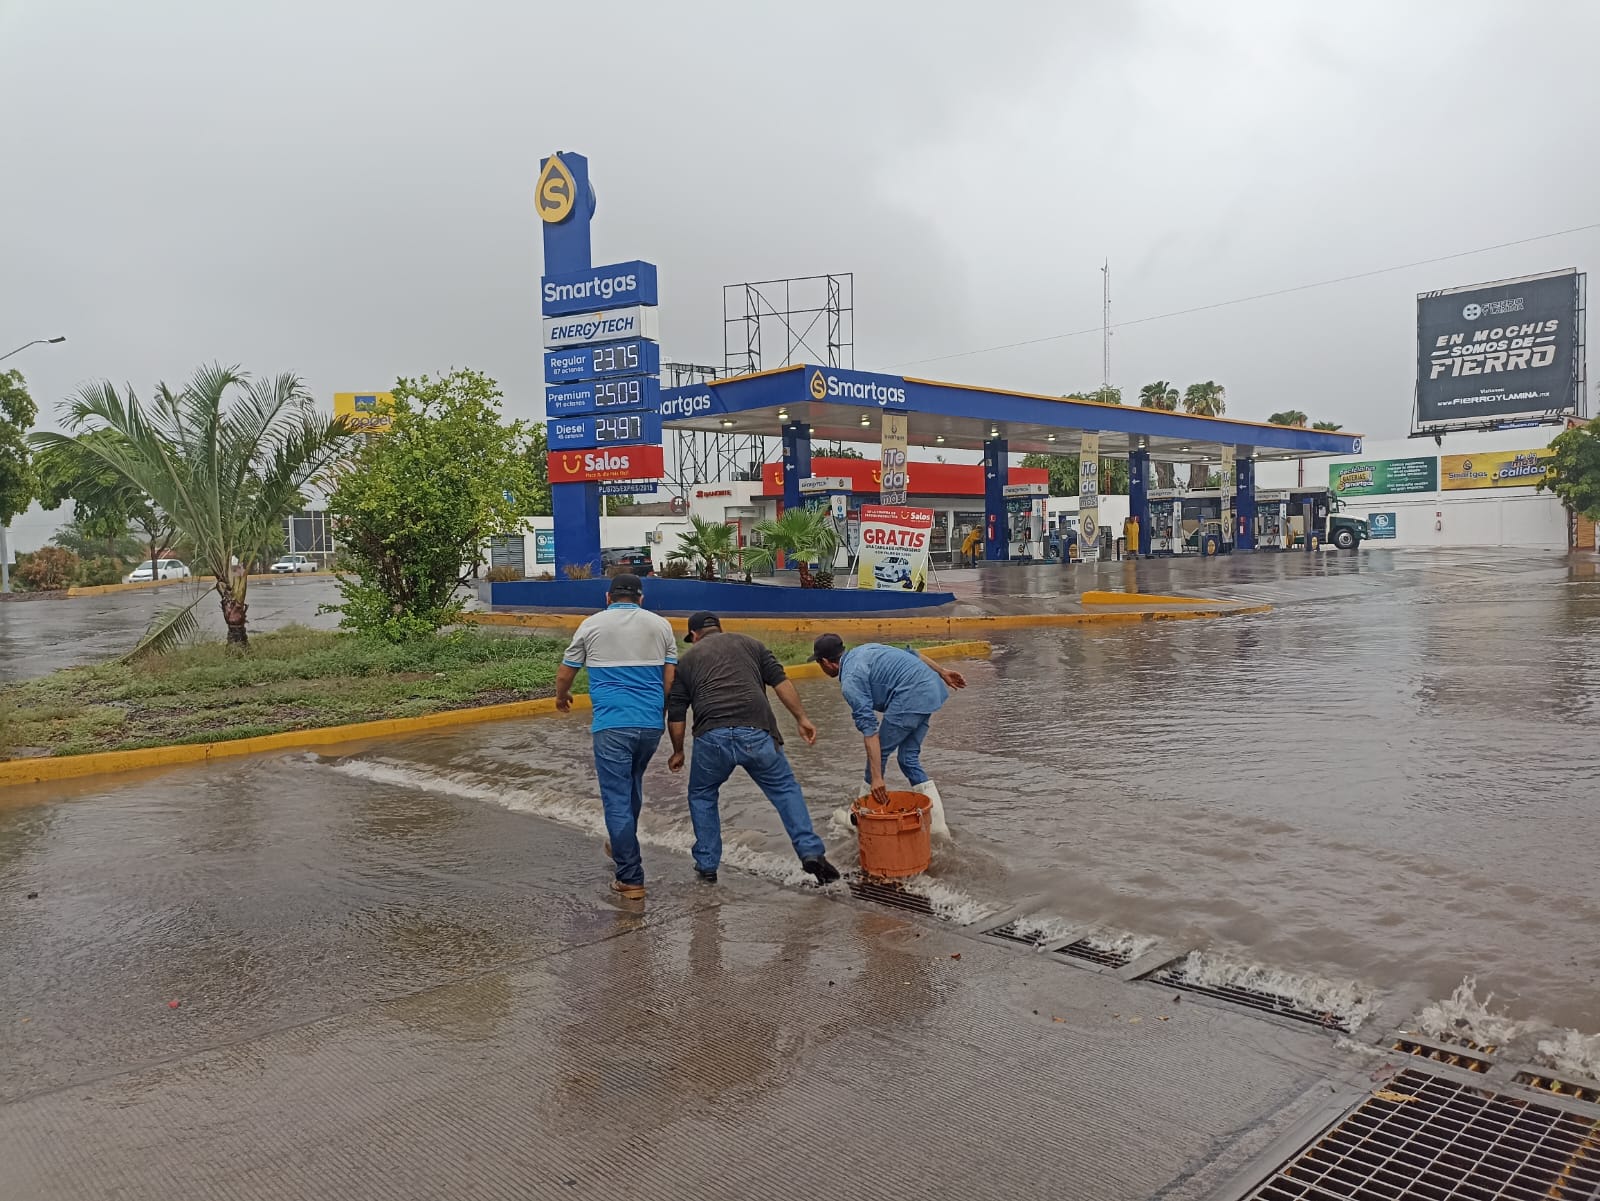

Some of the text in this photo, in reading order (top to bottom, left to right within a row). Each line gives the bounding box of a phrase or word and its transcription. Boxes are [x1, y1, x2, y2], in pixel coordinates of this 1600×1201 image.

[544, 274, 637, 302] Smartgas
[551, 315, 634, 340] ENERGYTECH
[1436, 319, 1559, 347] EN MOCHIS
[1451, 337, 1535, 357] SOMOS DE
[550, 355, 586, 368] Regular
[593, 345, 638, 371] 23.75
[1430, 344, 1556, 379] FIERRO
[548, 390, 591, 403] Premium
[595, 381, 640, 406] 25.09
[827, 375, 906, 405] Smartgas
[556, 422, 585, 435] Diesel
[596, 416, 641, 440] 24.97
[584, 451, 630, 471] Salos
[884, 448, 905, 467] ¡Te
[883, 468, 905, 489] da
[1448, 470, 1488, 480] Smartgas
[1081, 477, 1096, 494] da
[881, 491, 907, 505] más!
[910, 512, 931, 521] Salos
[863, 528, 925, 548] GRATIS
